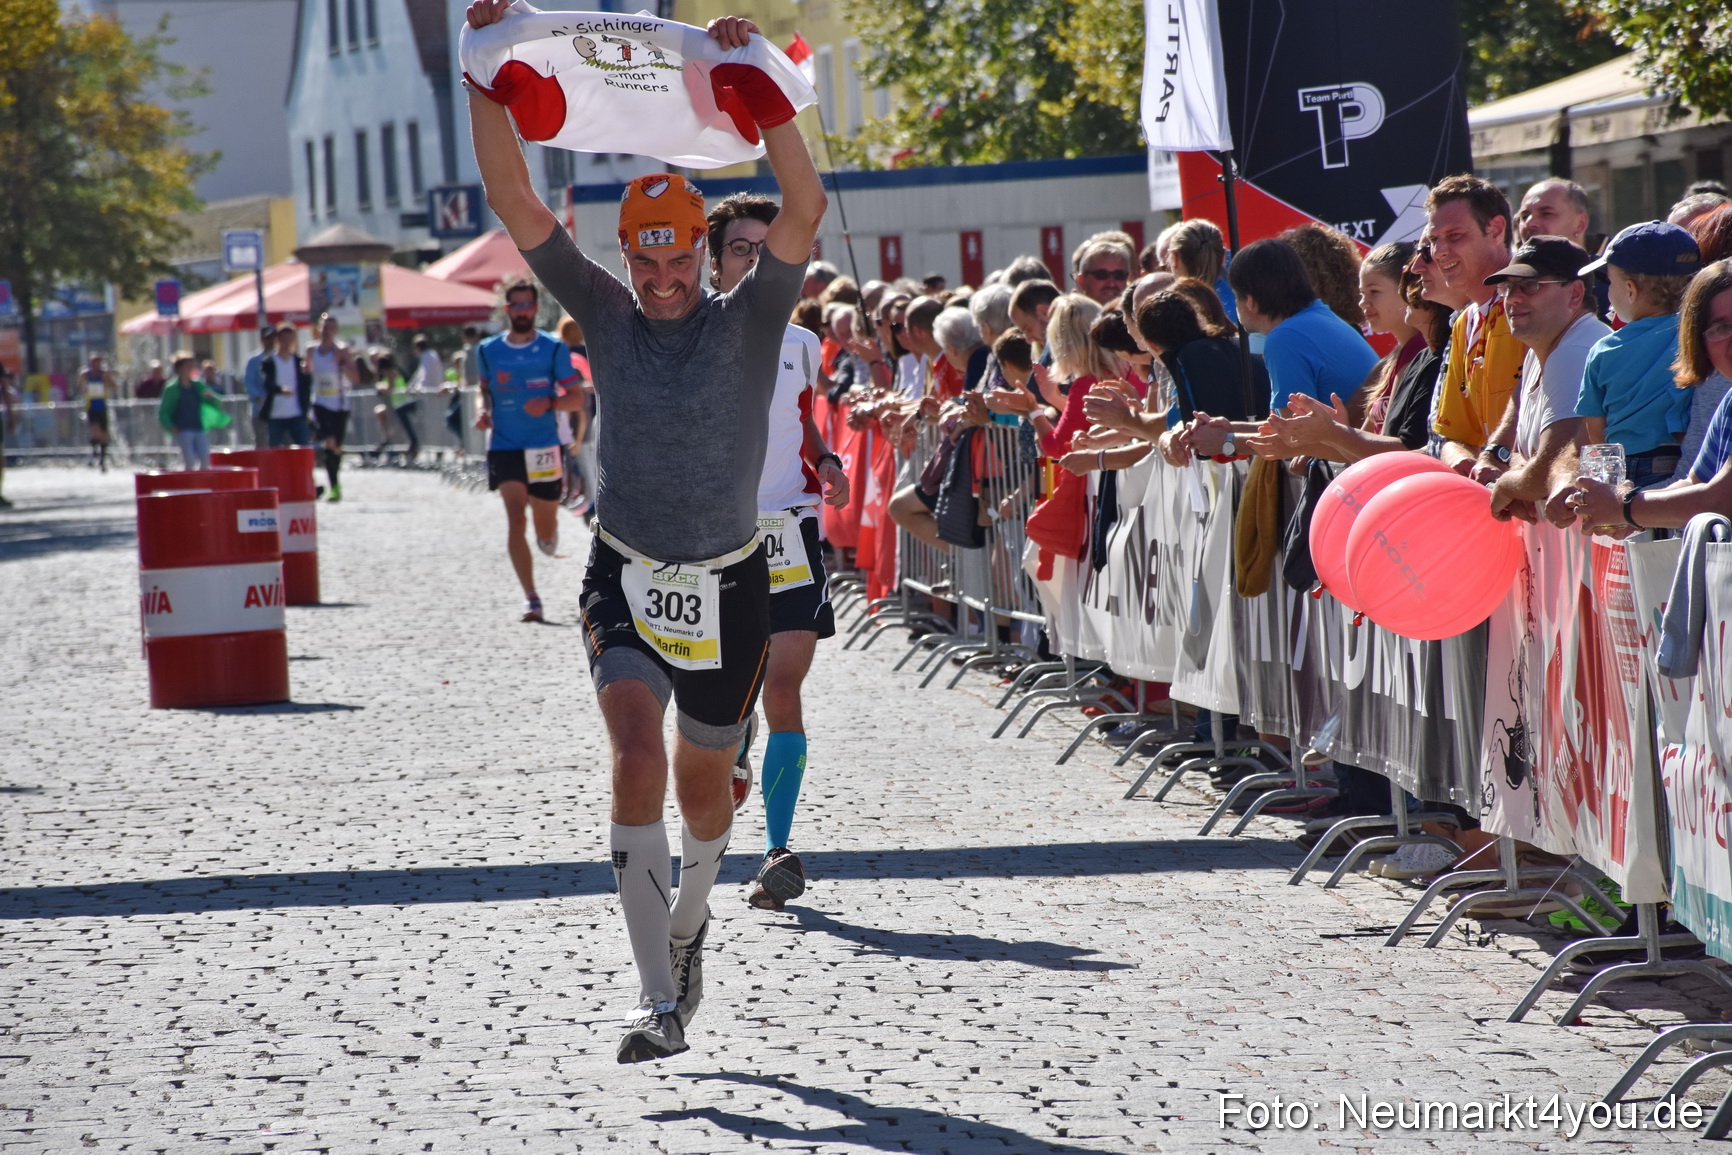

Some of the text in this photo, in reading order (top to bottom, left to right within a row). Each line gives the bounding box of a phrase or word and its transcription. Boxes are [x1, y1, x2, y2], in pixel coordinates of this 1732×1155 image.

[576, 18, 664, 34] Sichinger
[604, 78, 669, 92] Runners
[1305, 93, 1330, 104] Team
[652, 571, 699, 586] BOCK
[645, 588, 702, 625] 303
[664, 626, 694, 637] Neumarkt
[654, 635, 690, 657] Martin
